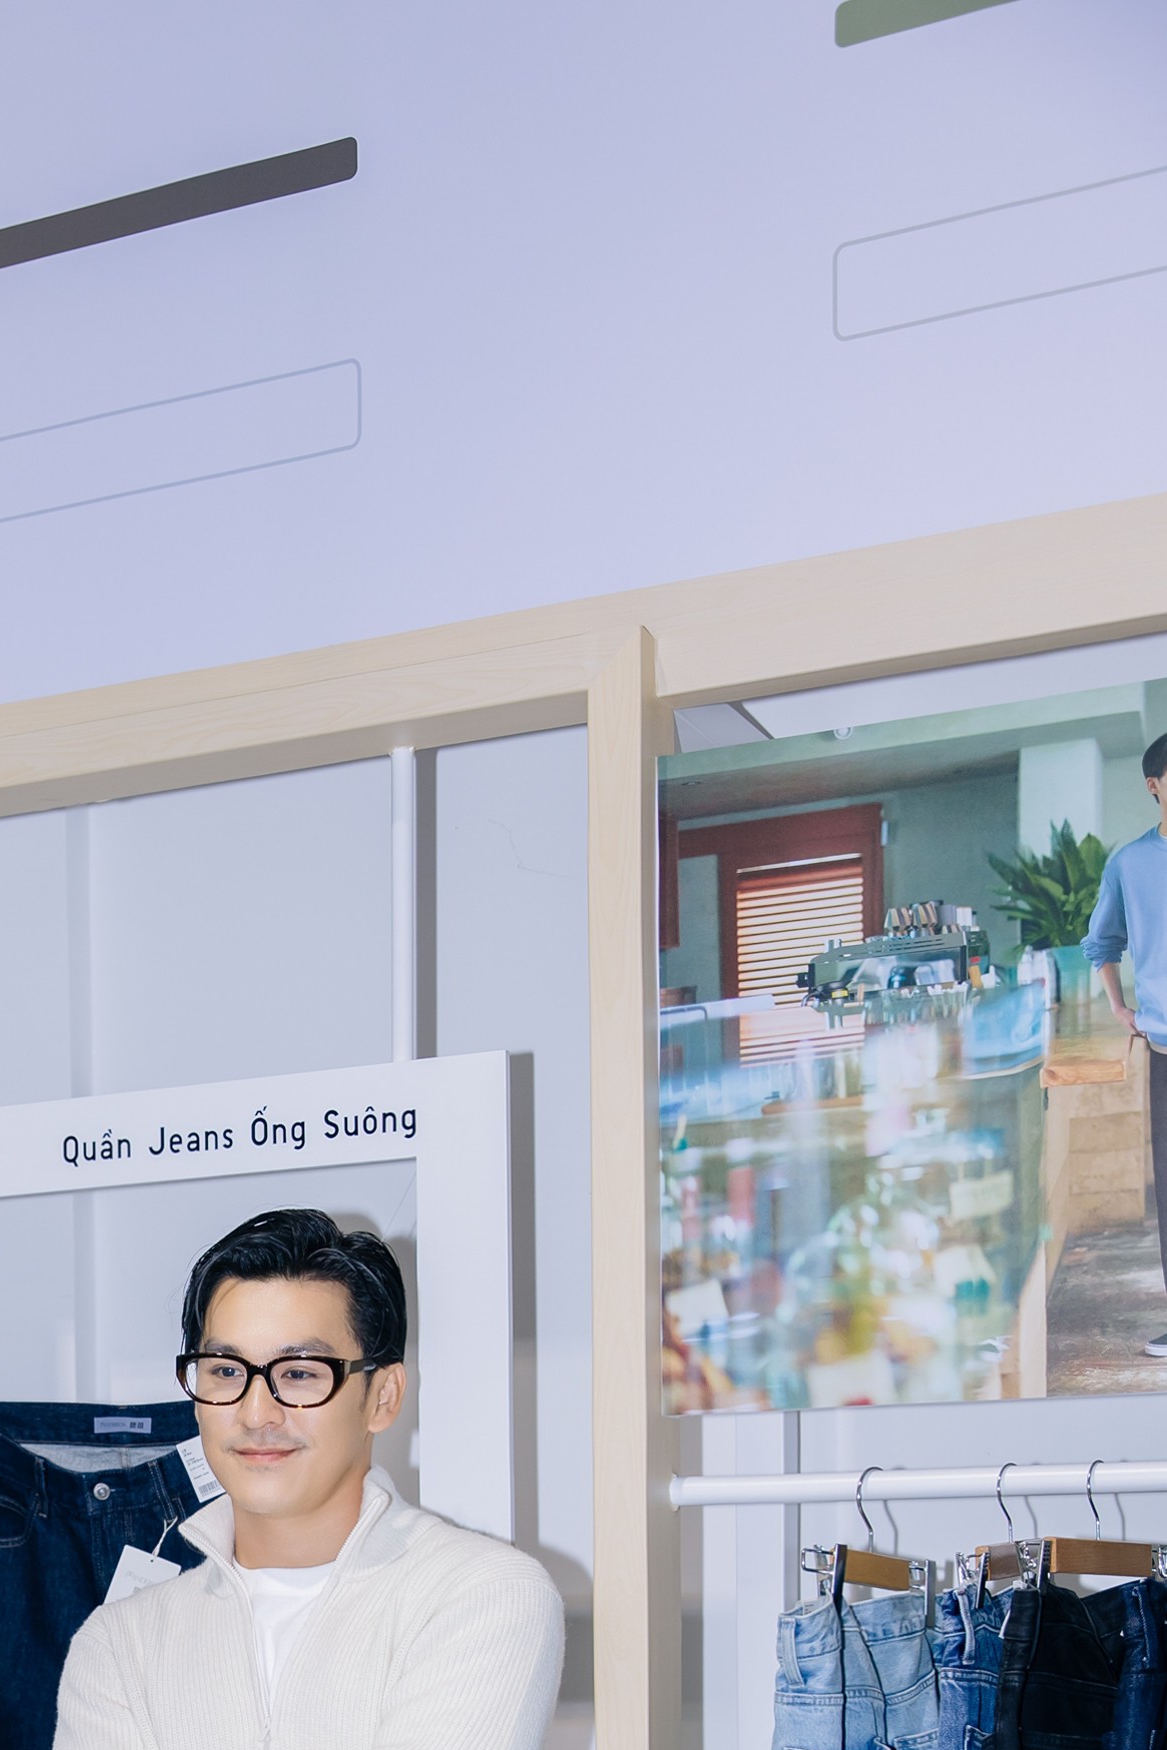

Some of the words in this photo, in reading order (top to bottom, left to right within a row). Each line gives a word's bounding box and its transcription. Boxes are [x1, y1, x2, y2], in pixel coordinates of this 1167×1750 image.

[62, 1128, 132, 1168] Quần
[148, 1126, 234, 1156] Jeans
[251, 1105, 306, 1151] Ống
[323, 1105, 417, 1140] Suông
